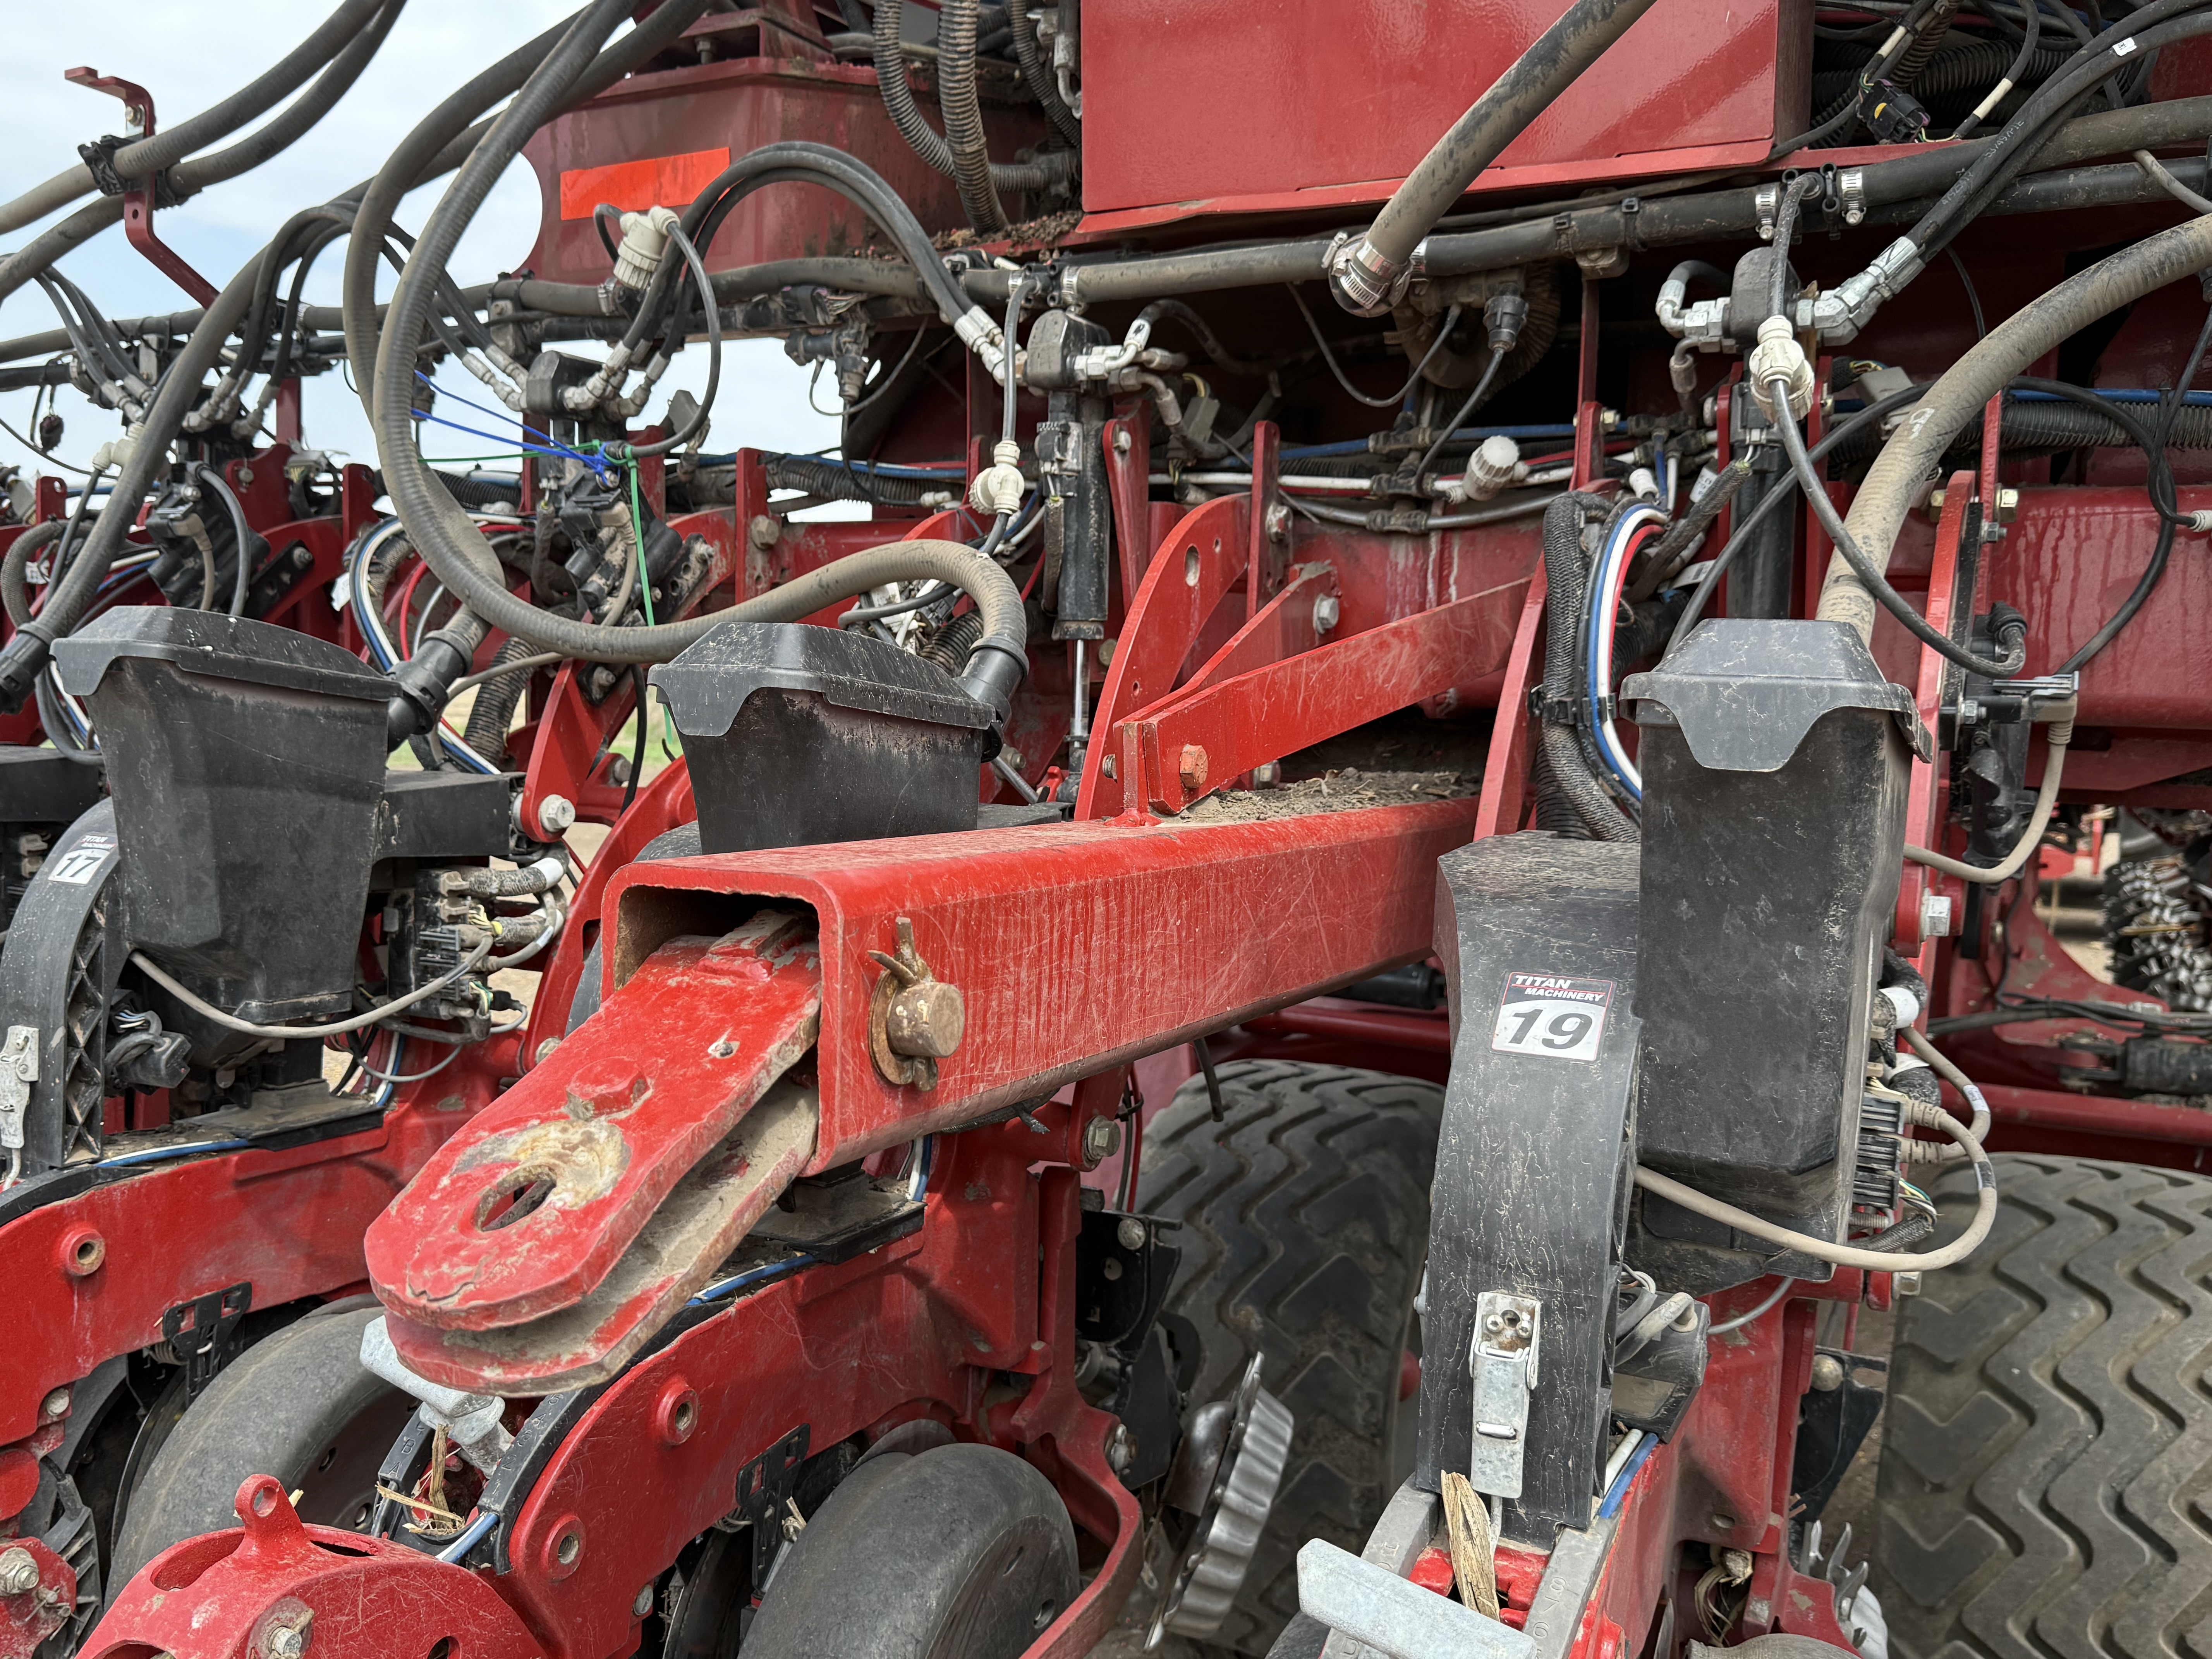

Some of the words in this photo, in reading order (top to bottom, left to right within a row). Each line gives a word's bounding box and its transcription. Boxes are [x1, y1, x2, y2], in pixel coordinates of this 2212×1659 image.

[56, 855, 102, 878] 17
[1515, 975, 1571, 989] TITAN
[1525, 987, 1604, 1002] MACHINERY
[1508, 1009, 1592, 1049] 19
[401, 1438, 416, 1454] B
[388, 1461, 401, 1478] A
[501, 1454, 517, 1470] 2
[1549, 1577, 1566, 1592] 8
[1541, 1595, 1560, 1613] 7
[1533, 1621, 1549, 1638] 6
[1340, 1637, 1360, 1657] D
